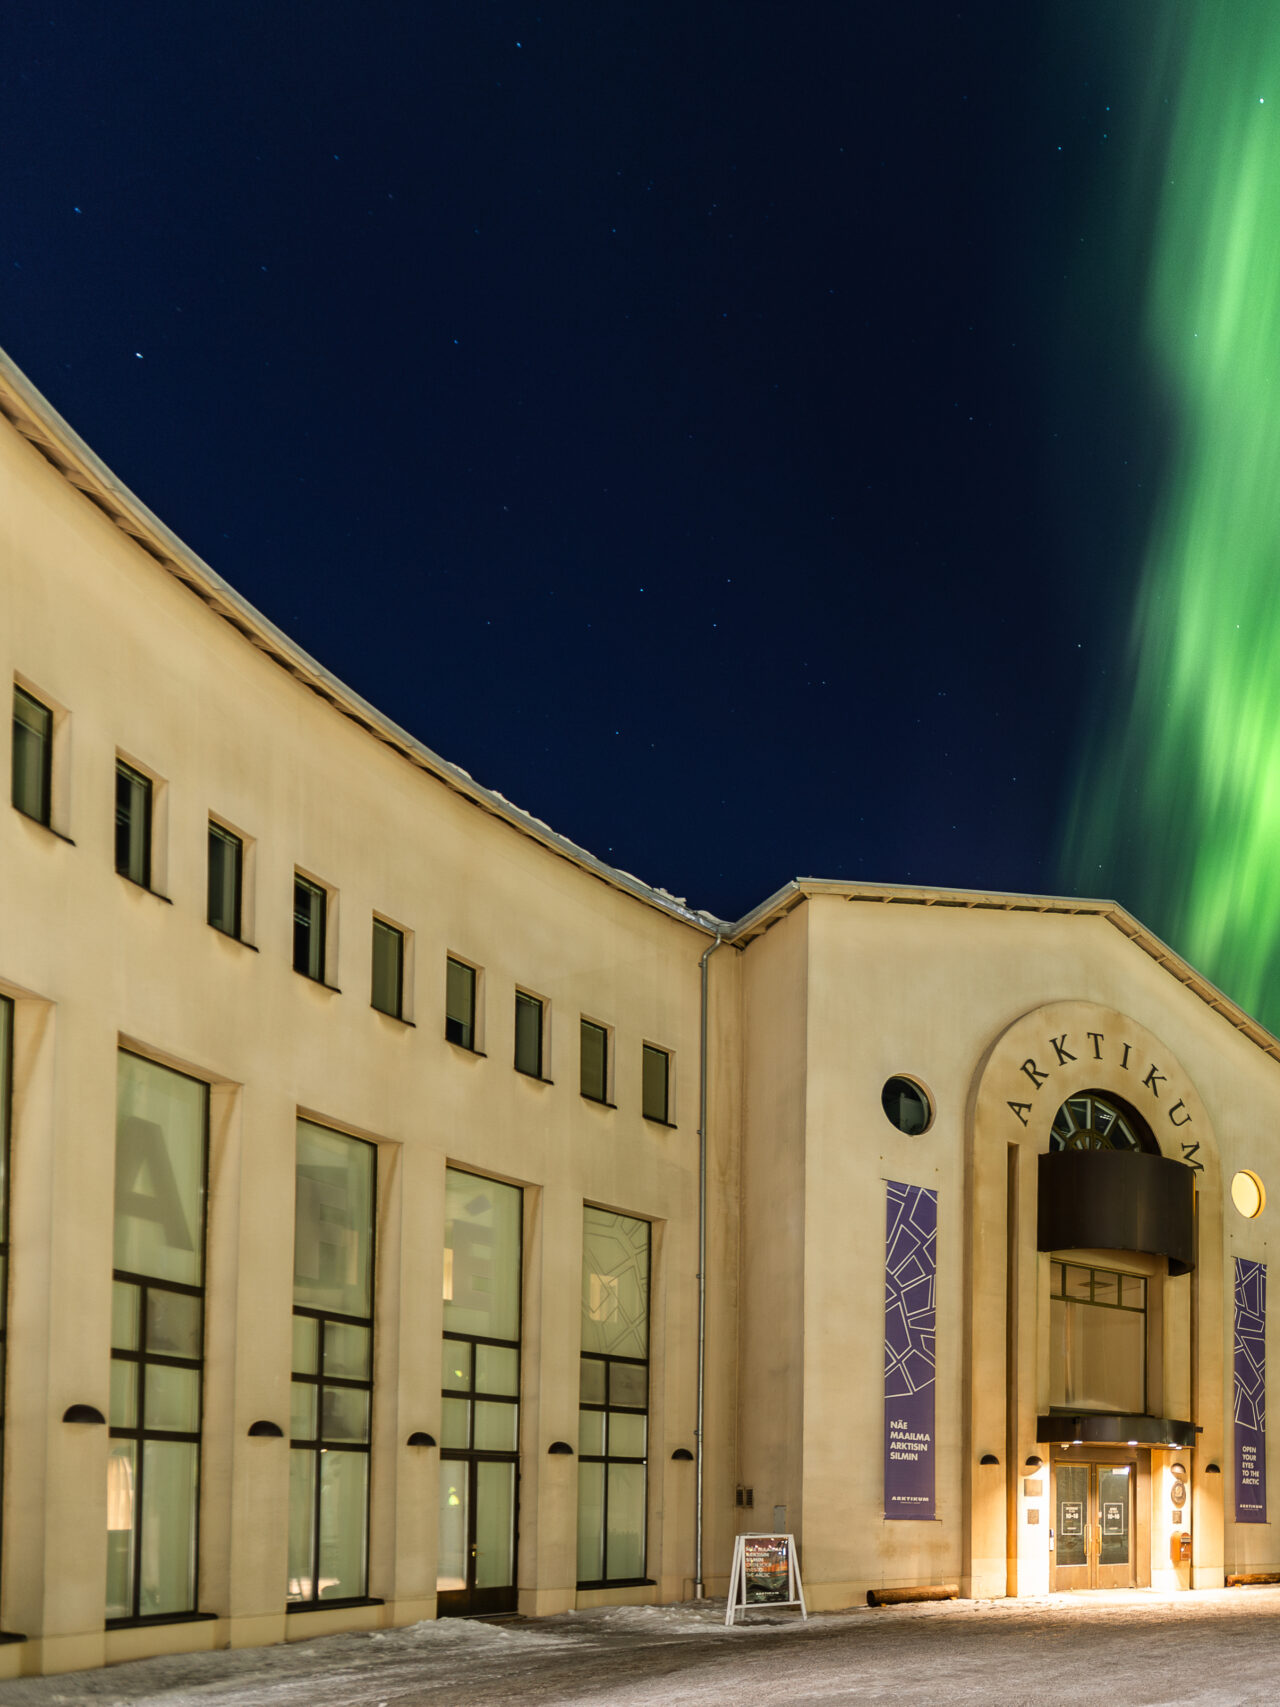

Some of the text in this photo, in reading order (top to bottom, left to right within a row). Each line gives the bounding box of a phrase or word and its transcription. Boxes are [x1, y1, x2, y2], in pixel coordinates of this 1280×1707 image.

[1007, 1032, 1204, 1172] ARKTIKUM
[890, 1431, 931, 1442] MAAILMA
[890, 1441, 928, 1451] ARKTISIN
[890, 1452, 918, 1461] SILMIN
